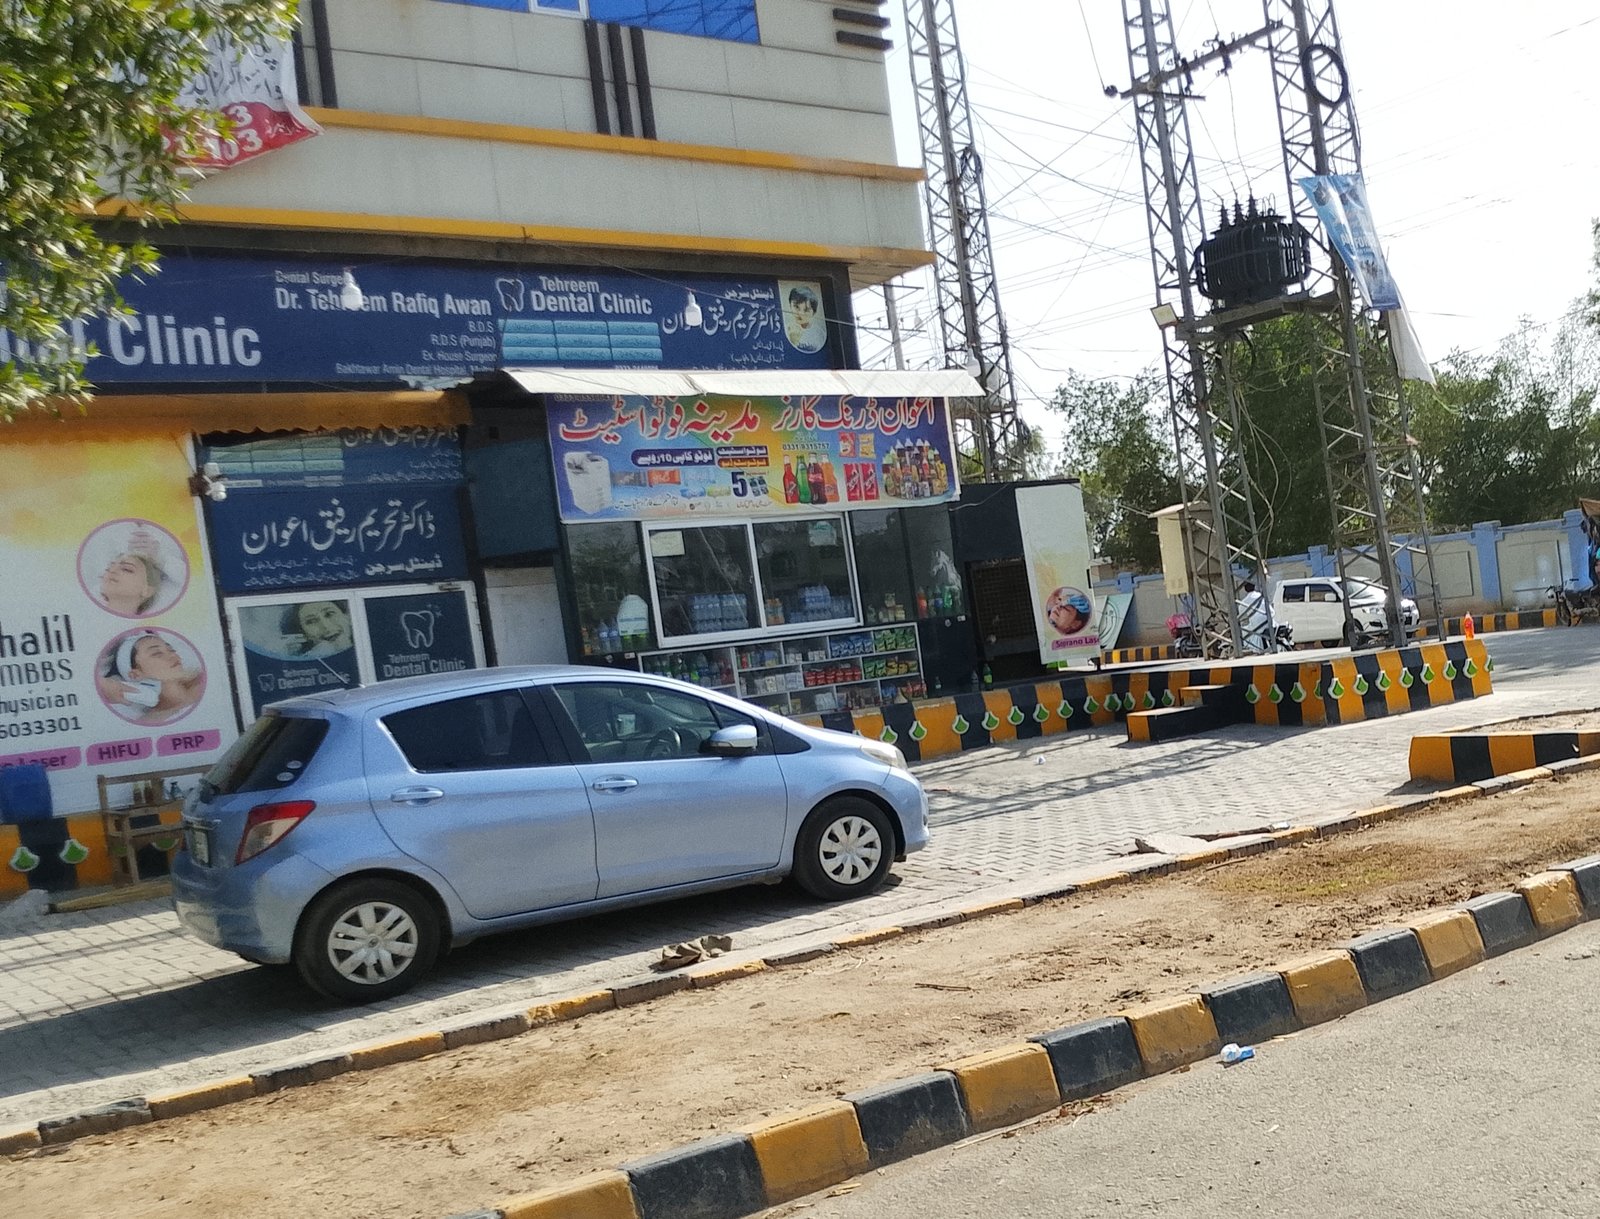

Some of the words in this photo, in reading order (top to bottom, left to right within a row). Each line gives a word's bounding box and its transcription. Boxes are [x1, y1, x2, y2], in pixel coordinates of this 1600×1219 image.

[312, 271, 347, 289] Surge
[539, 276, 599, 293] Tehreem
[275, 287, 303, 310] Dr.
[306, 289, 389, 313] Tehem
[391, 292, 440, 319] Rafiq
[443, 293, 492, 316] Awan
[530, 290, 595, 313] Dental
[599, 292, 653, 315] Clinic
[107, 313, 262, 367] Clinic
[731, 471, 748, 497] 5
[242, 516, 310, 555] اعوان
[309, 497, 356, 551] رفیق
[356, 499, 402, 552] تحریم
[393, 499, 437, 551] ڈاکٹر
[0, 658, 73, 687] MBBS
[383, 662, 427, 679] Dental
[429, 658, 467, 674] Clinic
[278, 676, 316, 691] Dental
[97, 742, 141, 761] HIFU
[171, 734, 205, 751] PRP
